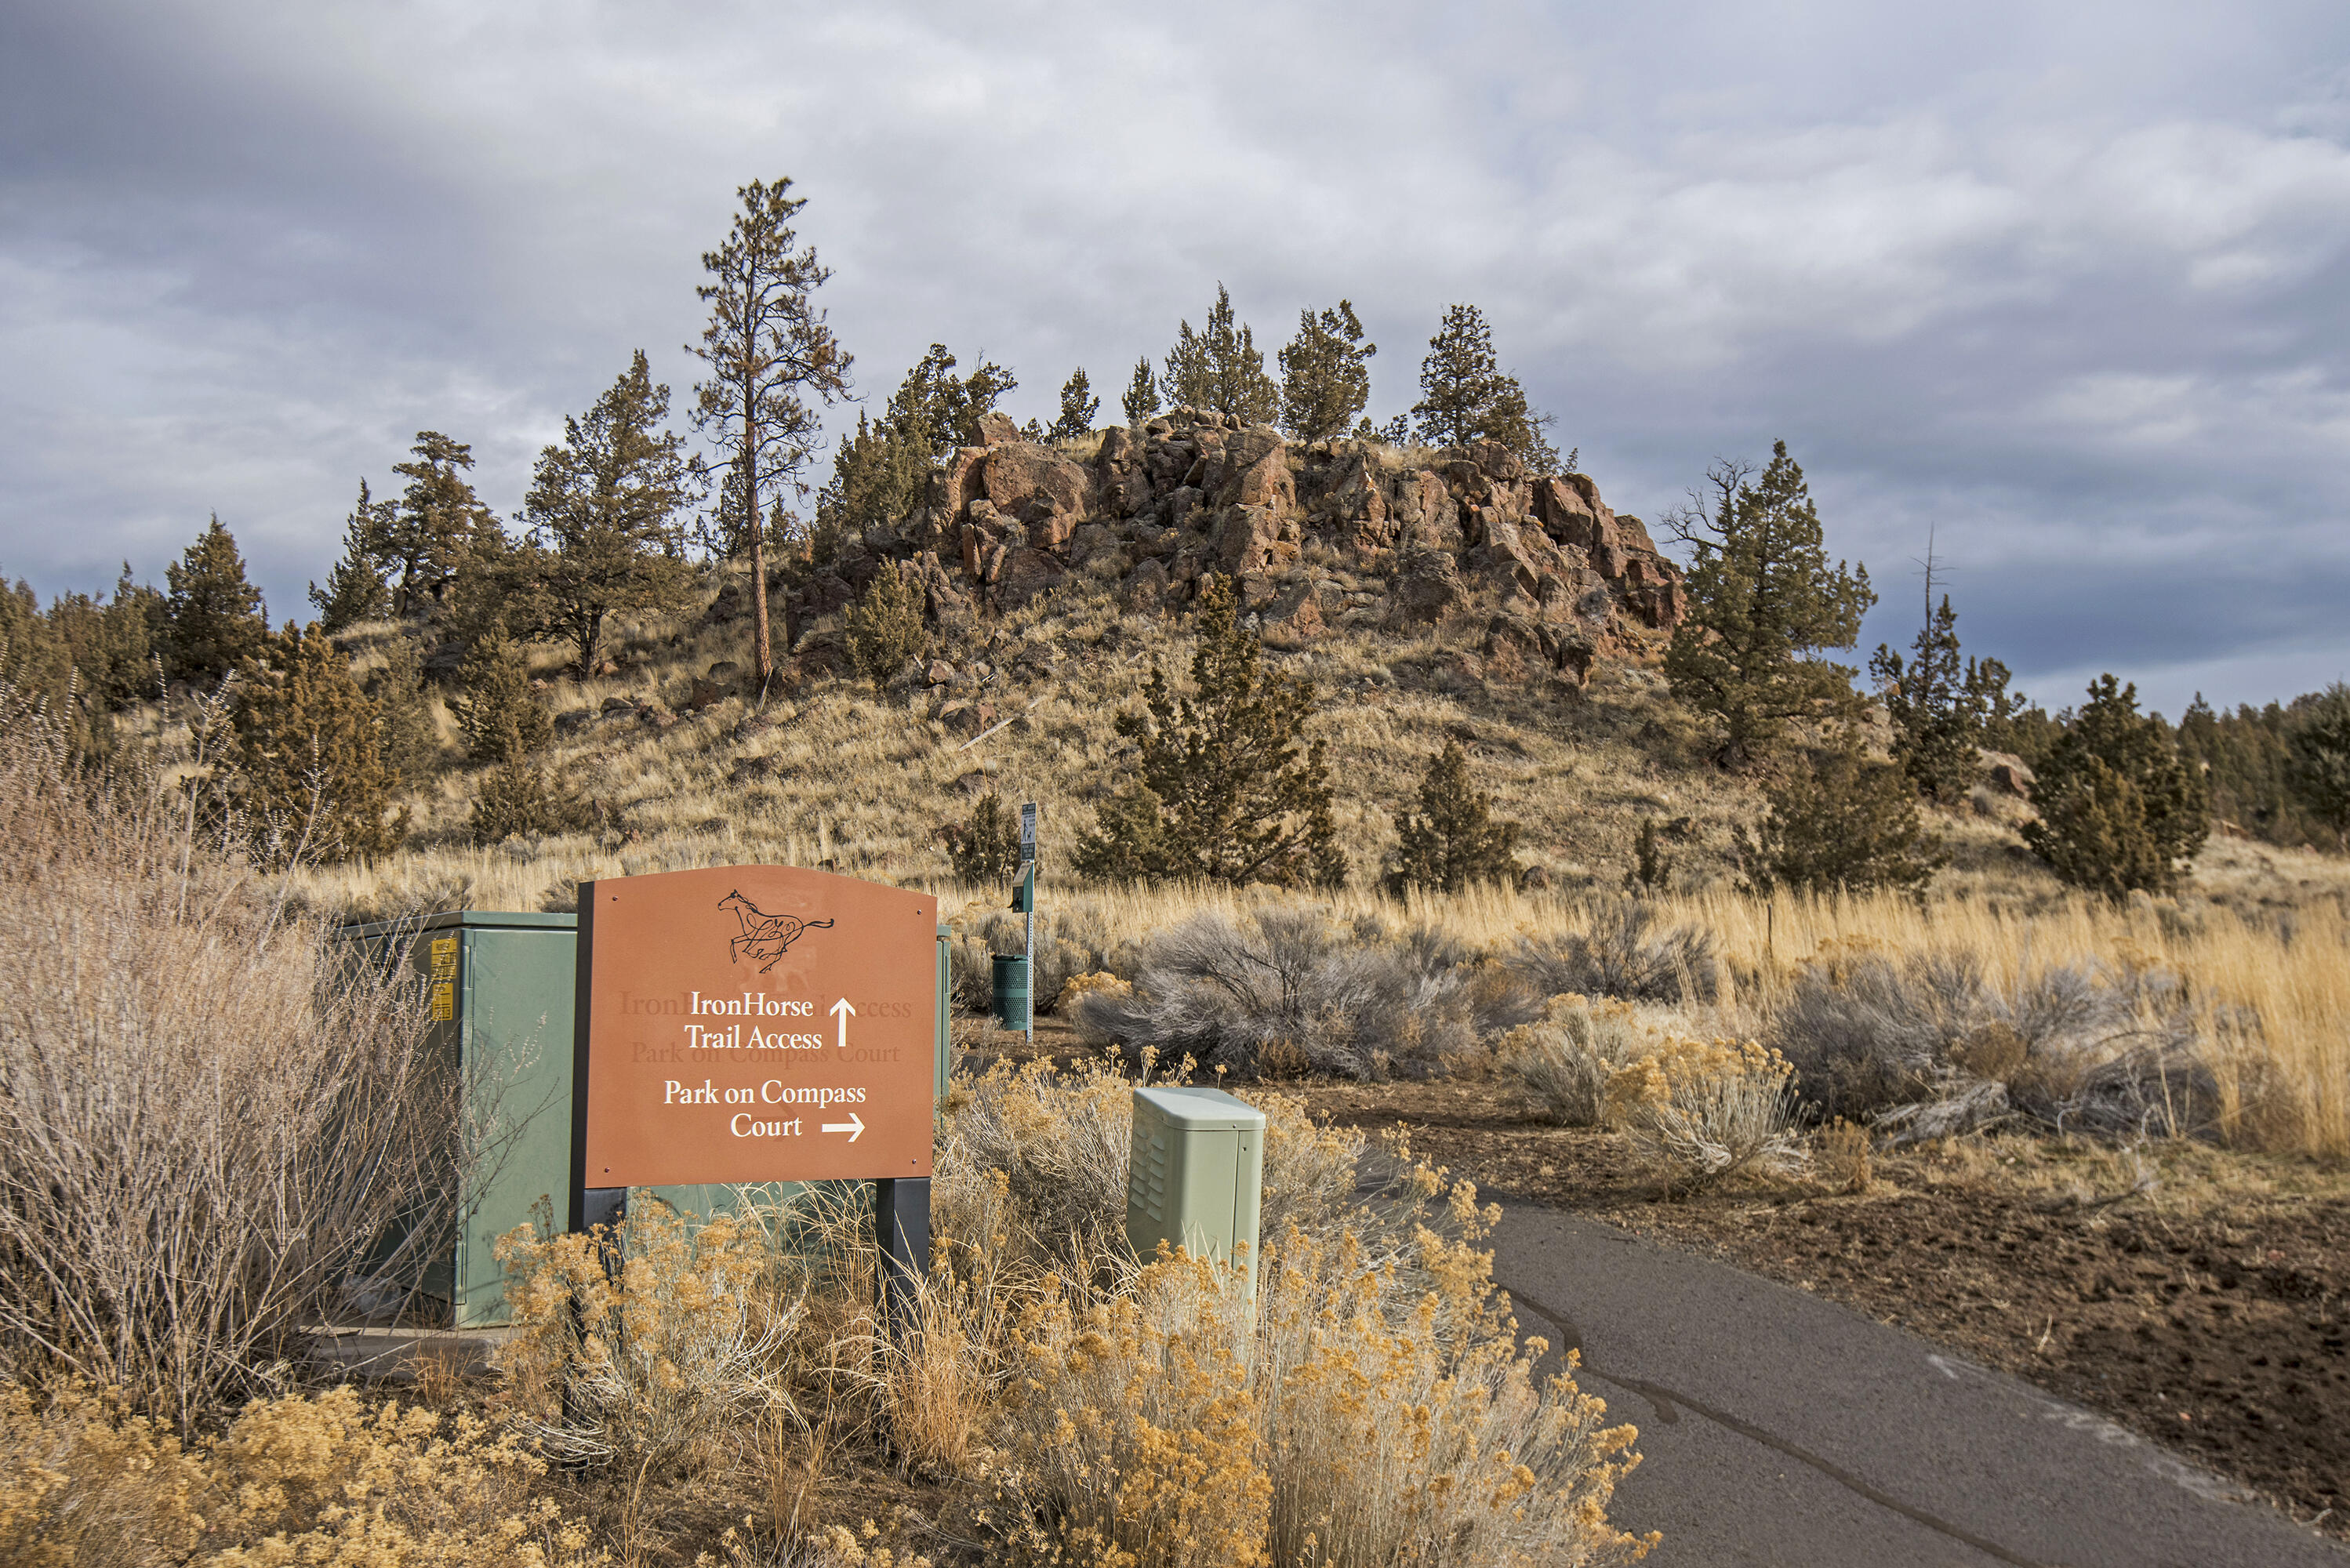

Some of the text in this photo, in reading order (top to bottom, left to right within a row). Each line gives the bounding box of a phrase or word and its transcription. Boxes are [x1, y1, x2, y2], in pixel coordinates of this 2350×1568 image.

[690, 991, 813, 1017] IronHorse
[684, 1024, 823, 1050] Trail Access
[663, 1078, 866, 1109] Park on Compass
[730, 1112, 803, 1138] Court
